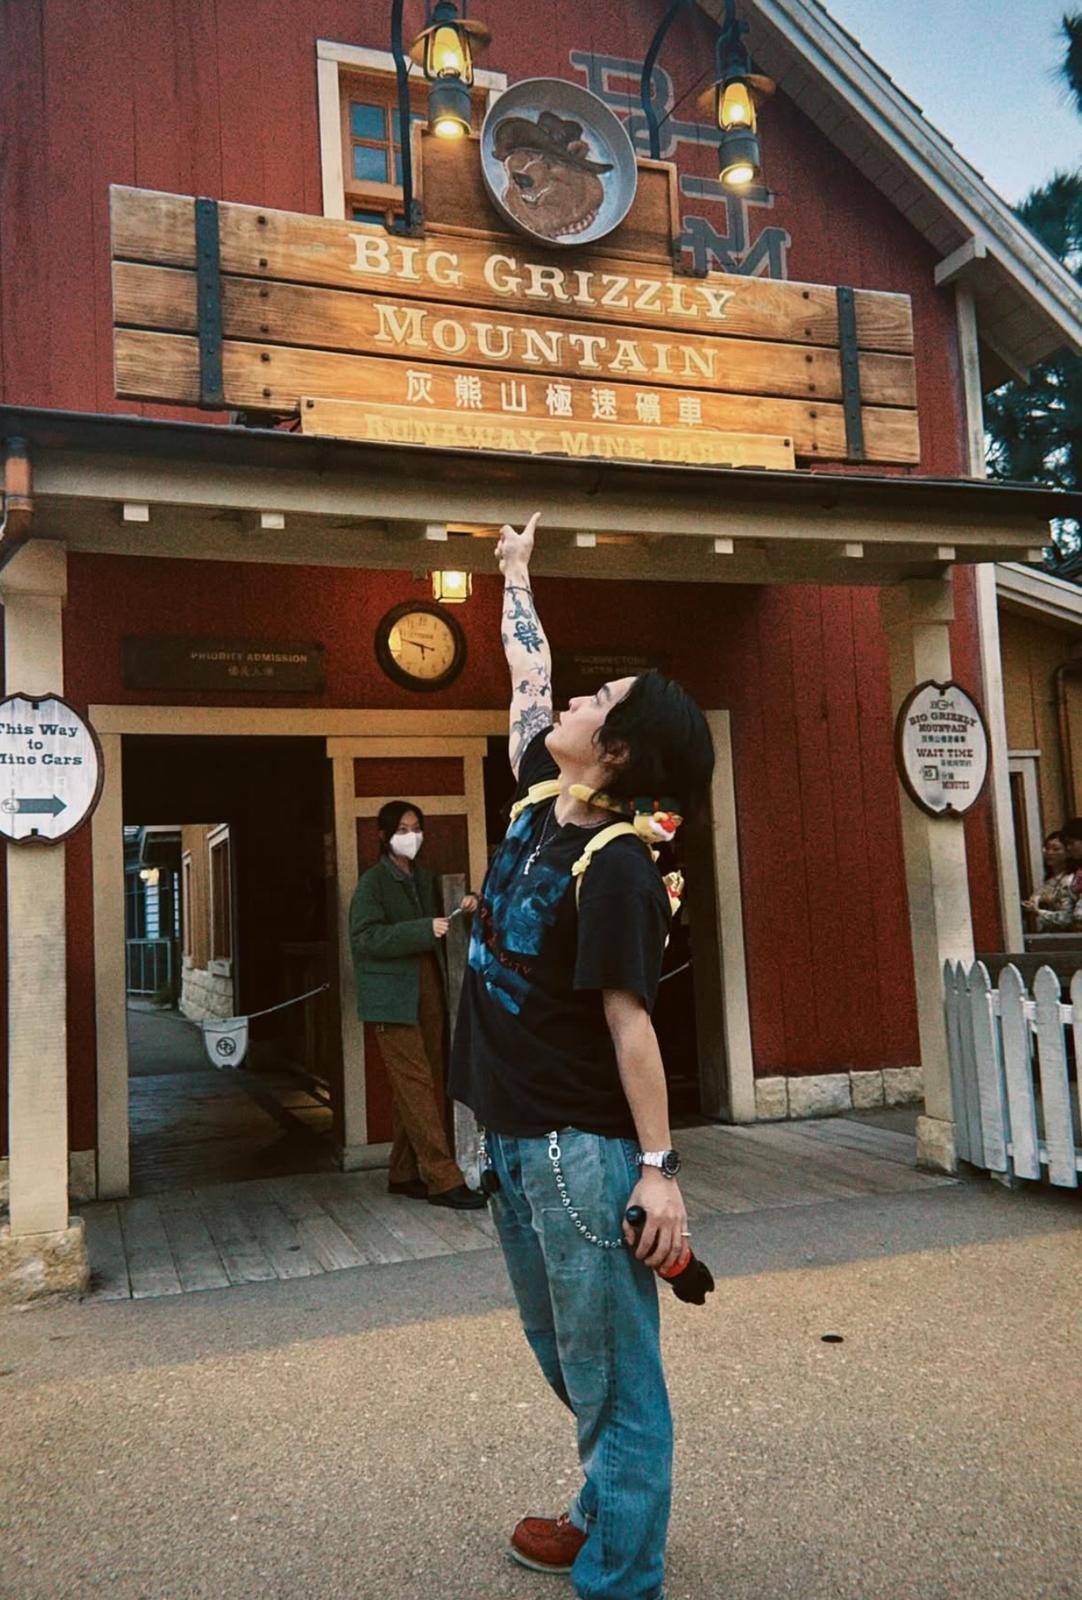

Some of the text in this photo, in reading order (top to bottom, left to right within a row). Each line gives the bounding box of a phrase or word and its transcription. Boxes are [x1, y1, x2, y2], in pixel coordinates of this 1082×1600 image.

[347, 232, 737, 321] BIG GRIZZLY
[372, 303, 719, 380] MOUNTAIN
[405, 368, 704, 427] 灰熊山極速礦車
[246, 653, 308, 663] ADMISSION
[39, 724, 78, 737] Way
[918, 724, 967, 733] MOUNTAIN
[28, 739, 43, 750] to
[916, 748, 974, 758] WAIT TIME
[42, 754, 82, 765] Cars
